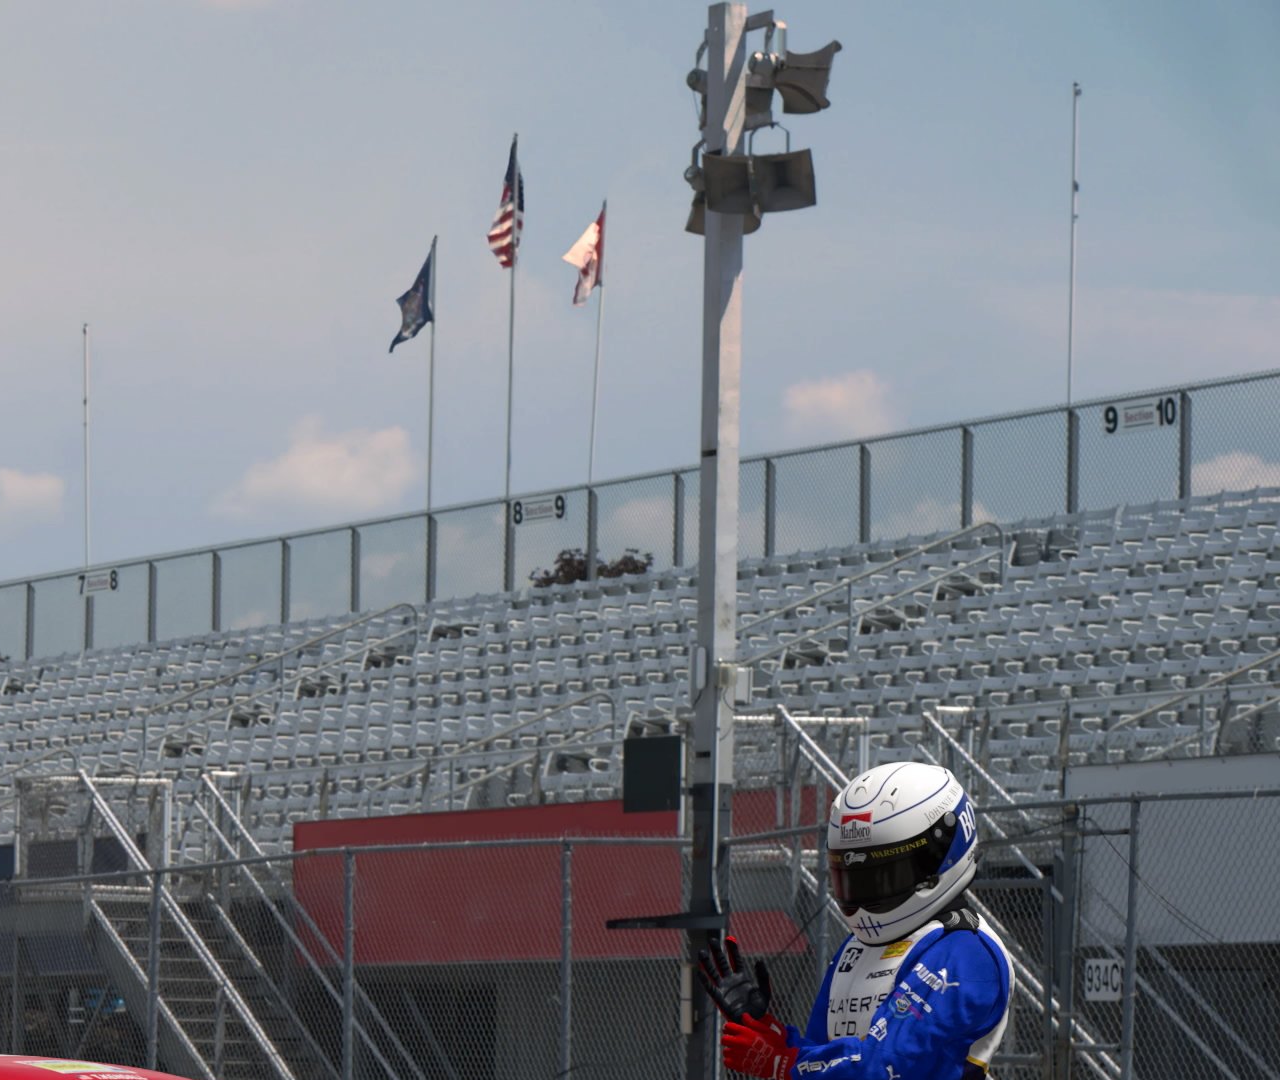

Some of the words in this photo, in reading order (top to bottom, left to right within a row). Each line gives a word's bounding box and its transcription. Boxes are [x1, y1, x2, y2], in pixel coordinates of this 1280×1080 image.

[1104, 406, 1118, 434] 9
[1156, 397, 1176, 426] 10
[513, 501, 523, 524] 8
[555, 495, 565, 519] 9
[78, 575, 86, 595] 7
[110, 569, 118, 591] 8
[840, 822, 871, 841] Marlboro
[870, 838, 928, 859] WARSTEINER
[913, 963, 943, 991] PUMA
[1087, 963, 1119, 992] 934C
